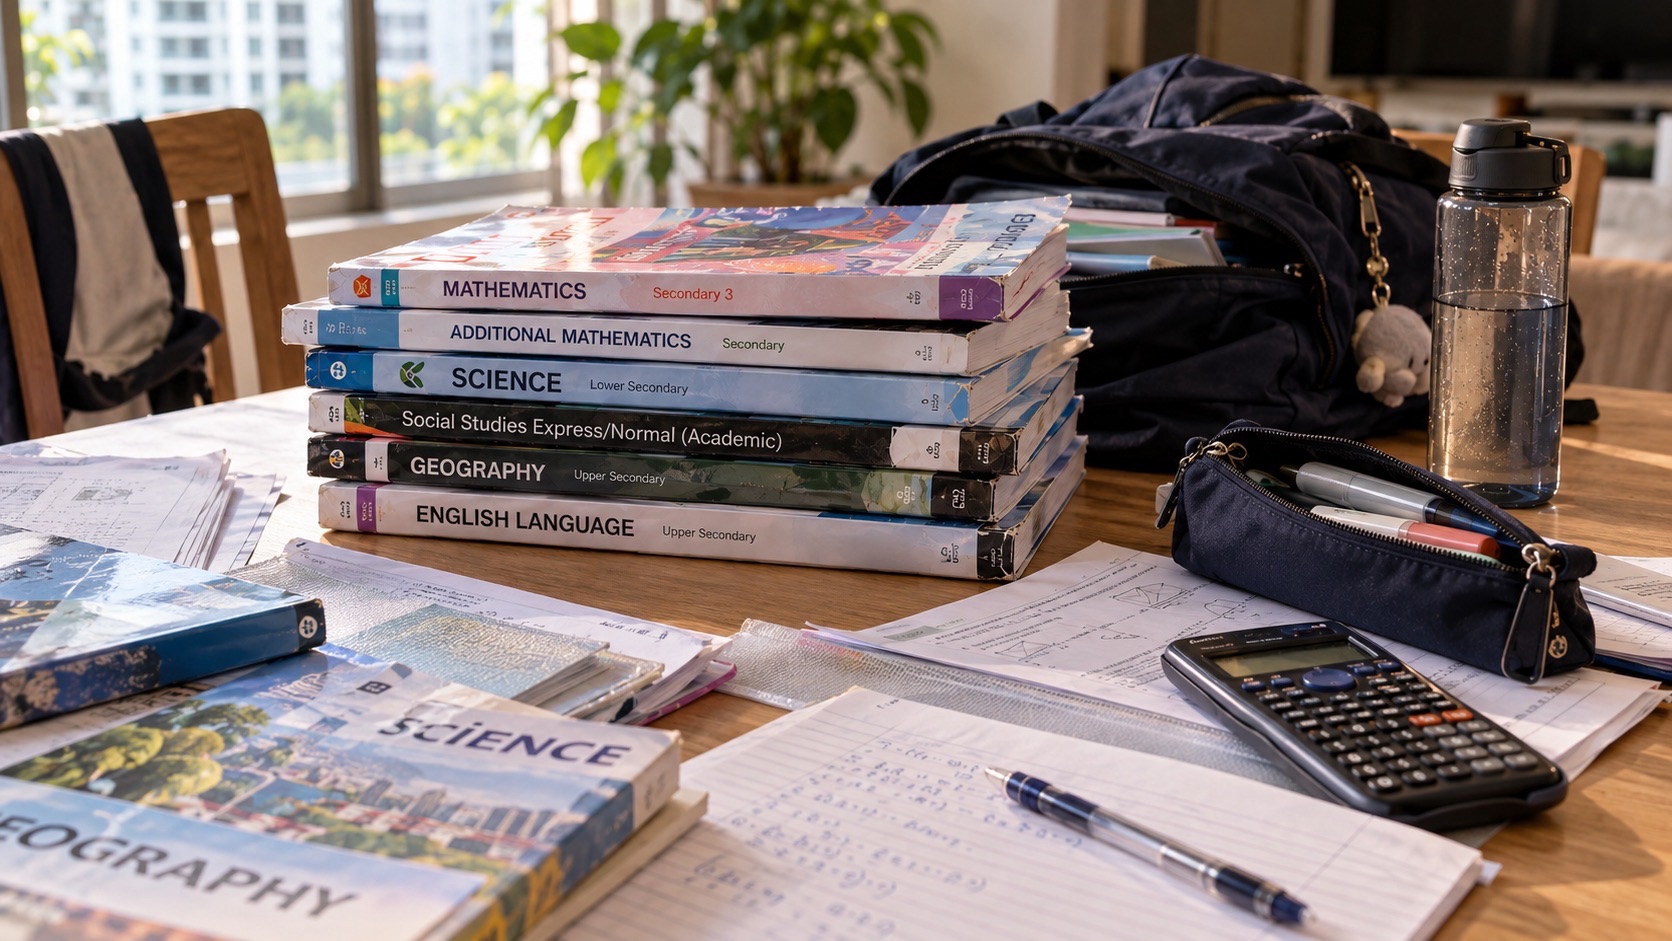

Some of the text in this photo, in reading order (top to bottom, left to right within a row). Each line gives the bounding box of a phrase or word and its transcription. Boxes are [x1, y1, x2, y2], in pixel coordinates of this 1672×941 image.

[442, 281, 587, 301] MATHEMATICS
[652, 286, 735, 303] Secondary 3
[451, 323, 692, 350] ADDITIONAL MATHEMATICS
[722, 338, 785, 354] Secondary
[452, 367, 562, 393] SCIENCE
[590, 378, 689, 395] Lower Secondary
[402, 411, 783, 451] Social Studies Express/Normal (Academic)
[410, 456, 546, 482] GEOGRAPHY
[573, 468, 667, 487] Upper Secondary
[416, 505, 635, 536] ENGLISH LANGUAGE
[661, 526, 757, 544] Upper Secondary
[0, 810, 356, 919] EOGRAPHY
